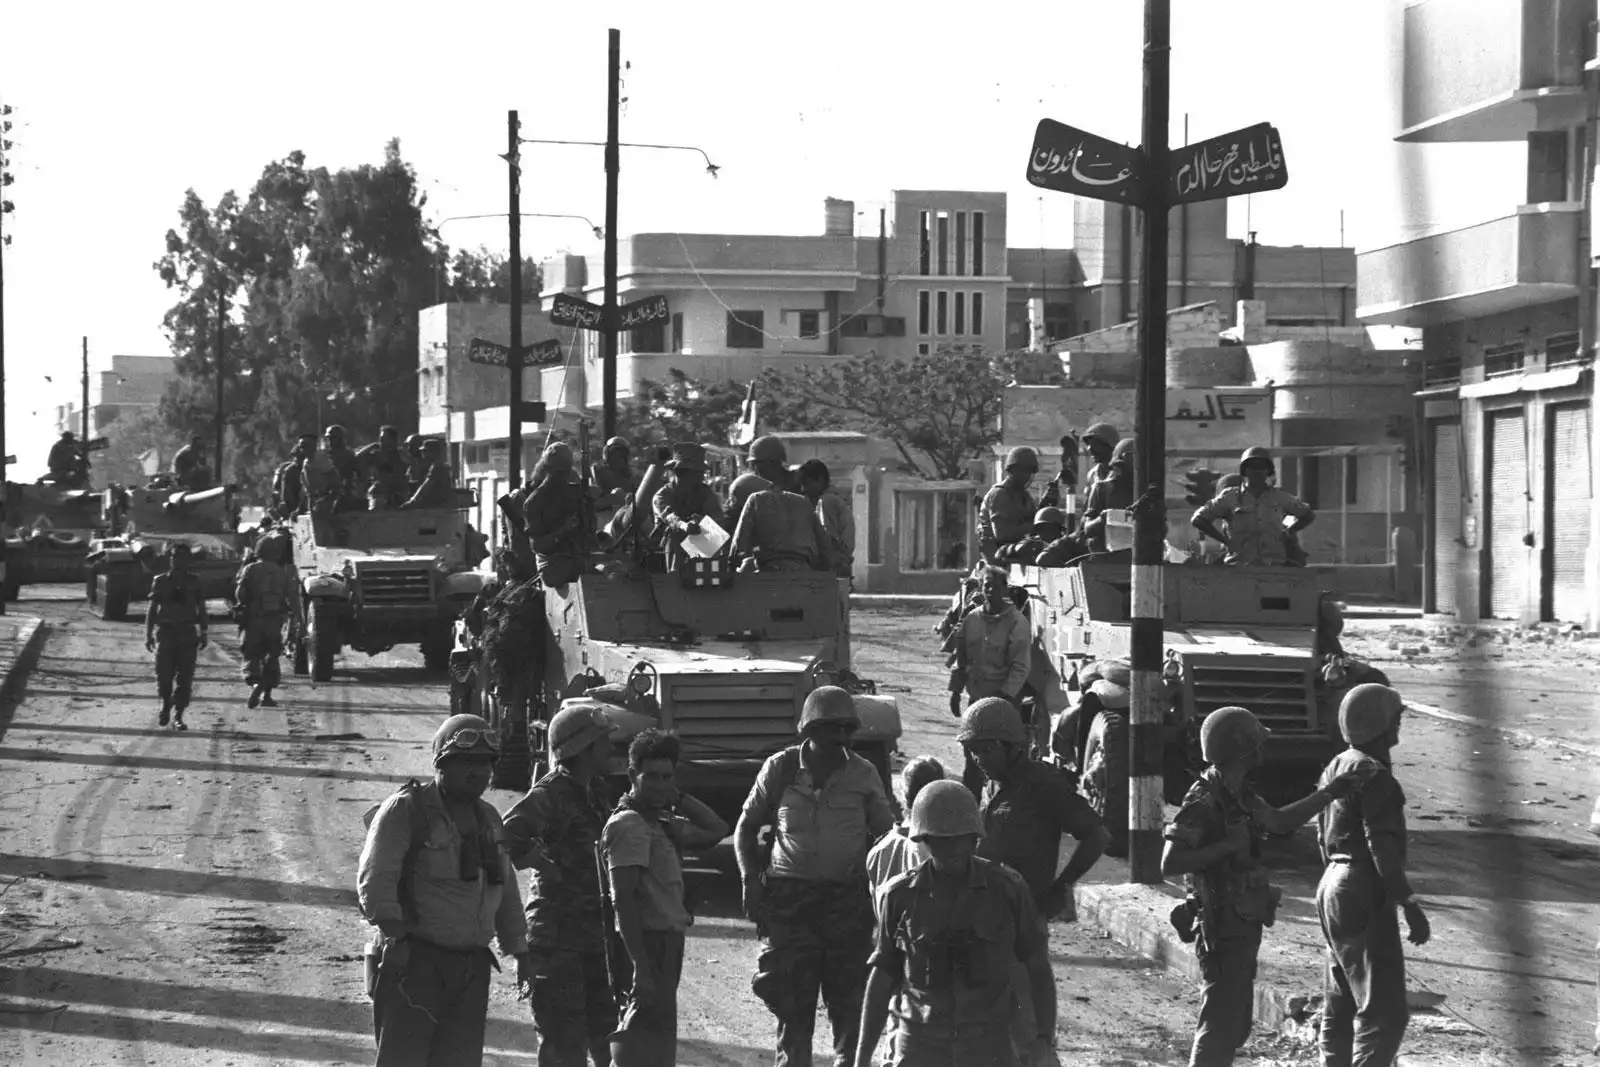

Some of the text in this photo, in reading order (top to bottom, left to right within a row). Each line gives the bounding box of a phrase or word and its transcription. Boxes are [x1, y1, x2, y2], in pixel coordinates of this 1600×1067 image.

[1032, 140, 1132, 186] عائدون
[1176, 151, 1208, 195] الدم
[1228, 134, 1282, 186] فلسطين
